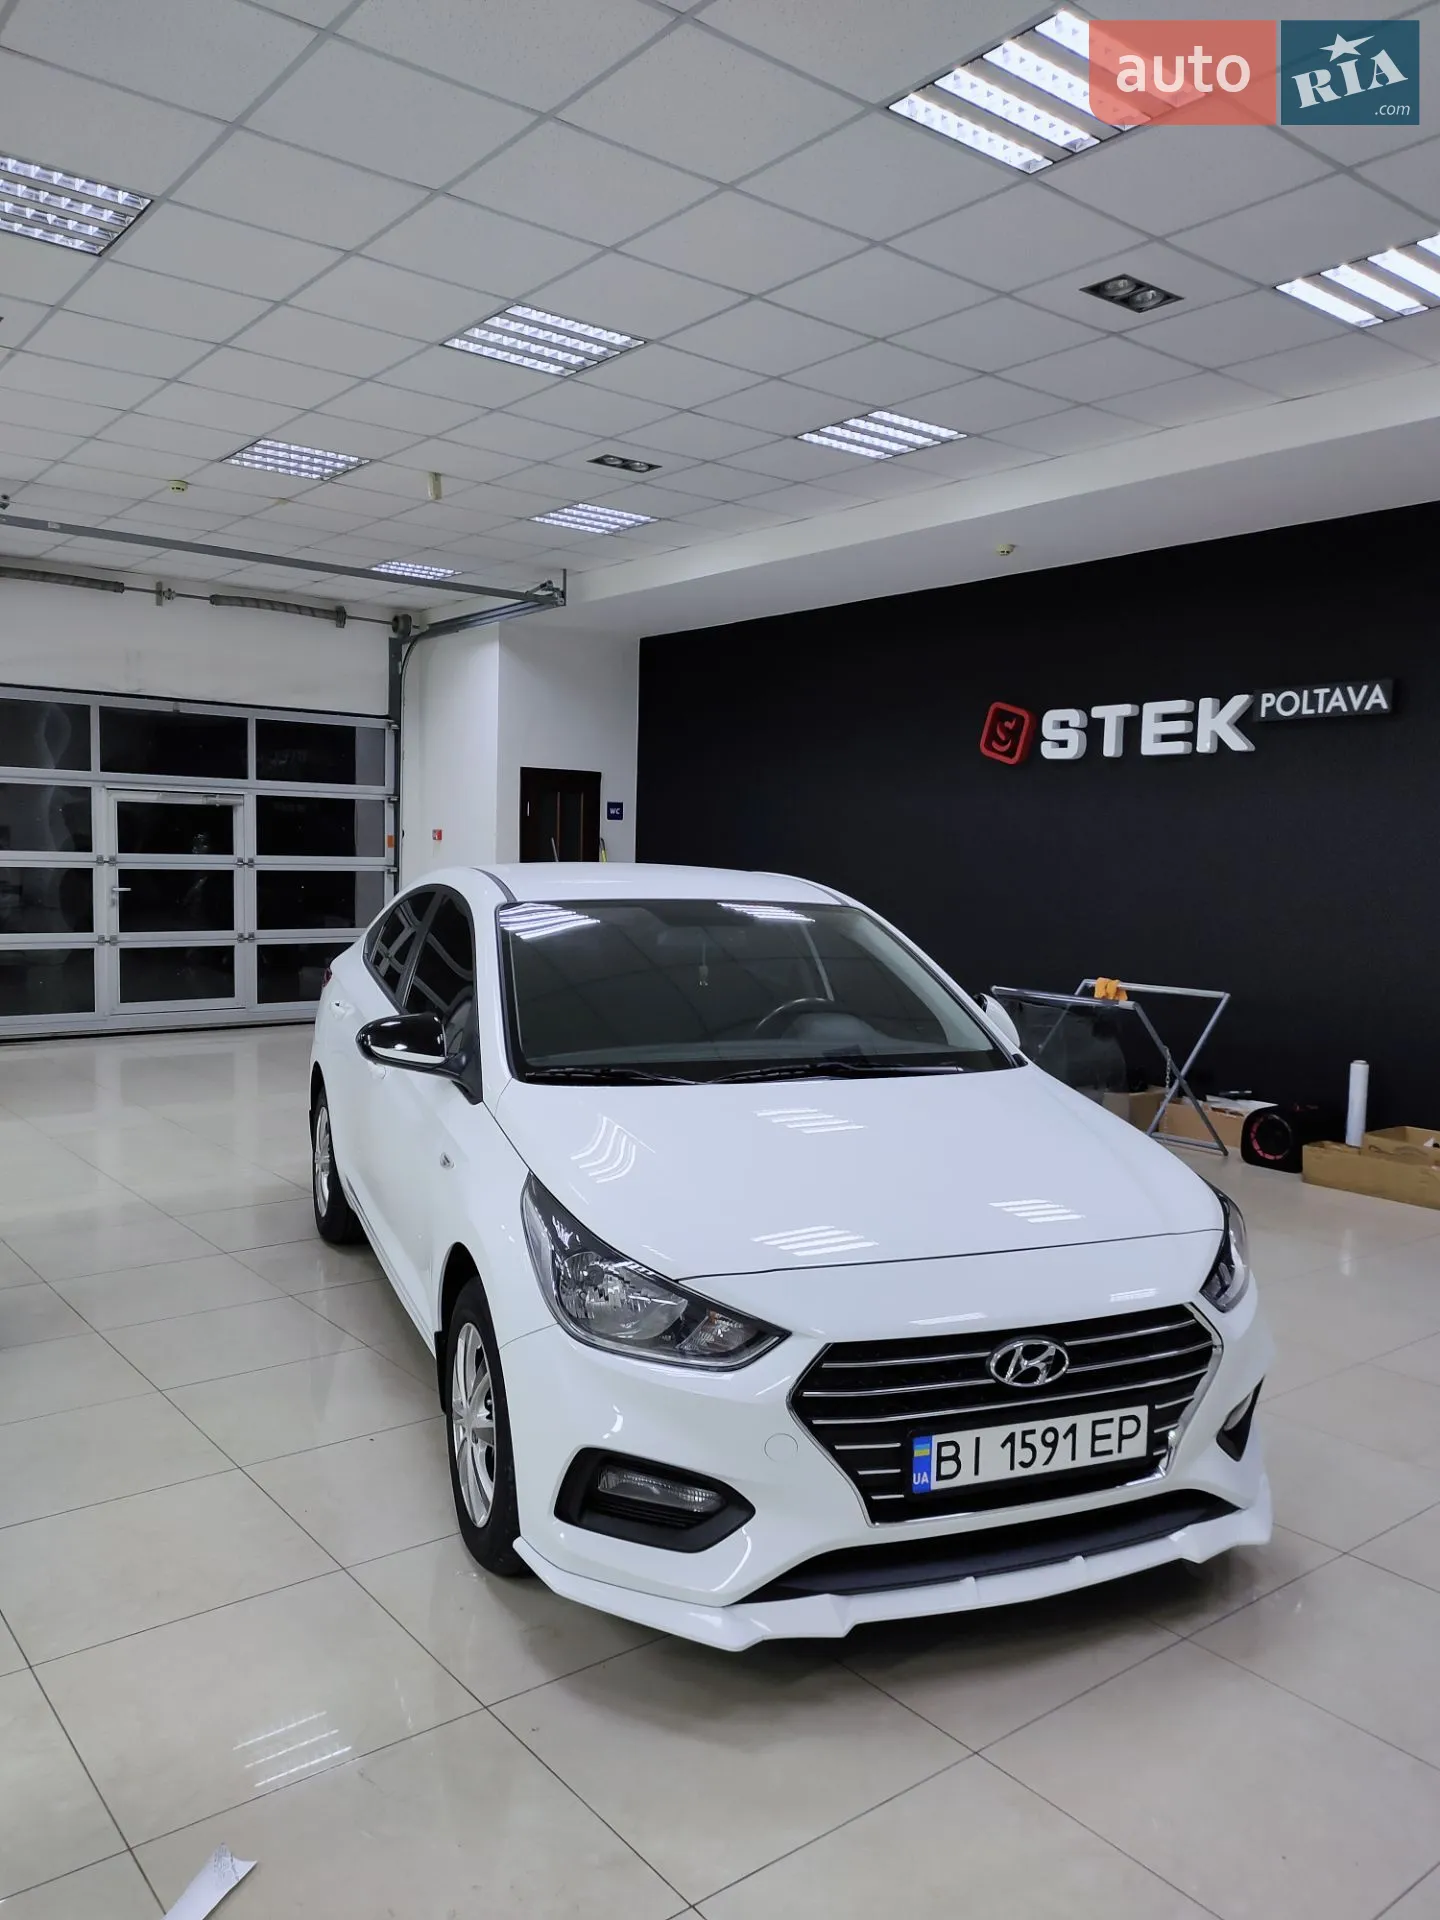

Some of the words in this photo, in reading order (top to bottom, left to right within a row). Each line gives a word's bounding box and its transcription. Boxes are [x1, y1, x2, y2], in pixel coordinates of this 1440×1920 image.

[1260, 684, 1389, 718] POLTAVA
[1041, 694, 1256, 760] STEK
[609, 807, 621, 815] WC
[1000, 1423, 1078, 1471] 1591
[1090, 1414, 1142, 1458] EP
[912, 1472, 929, 1485] UA
